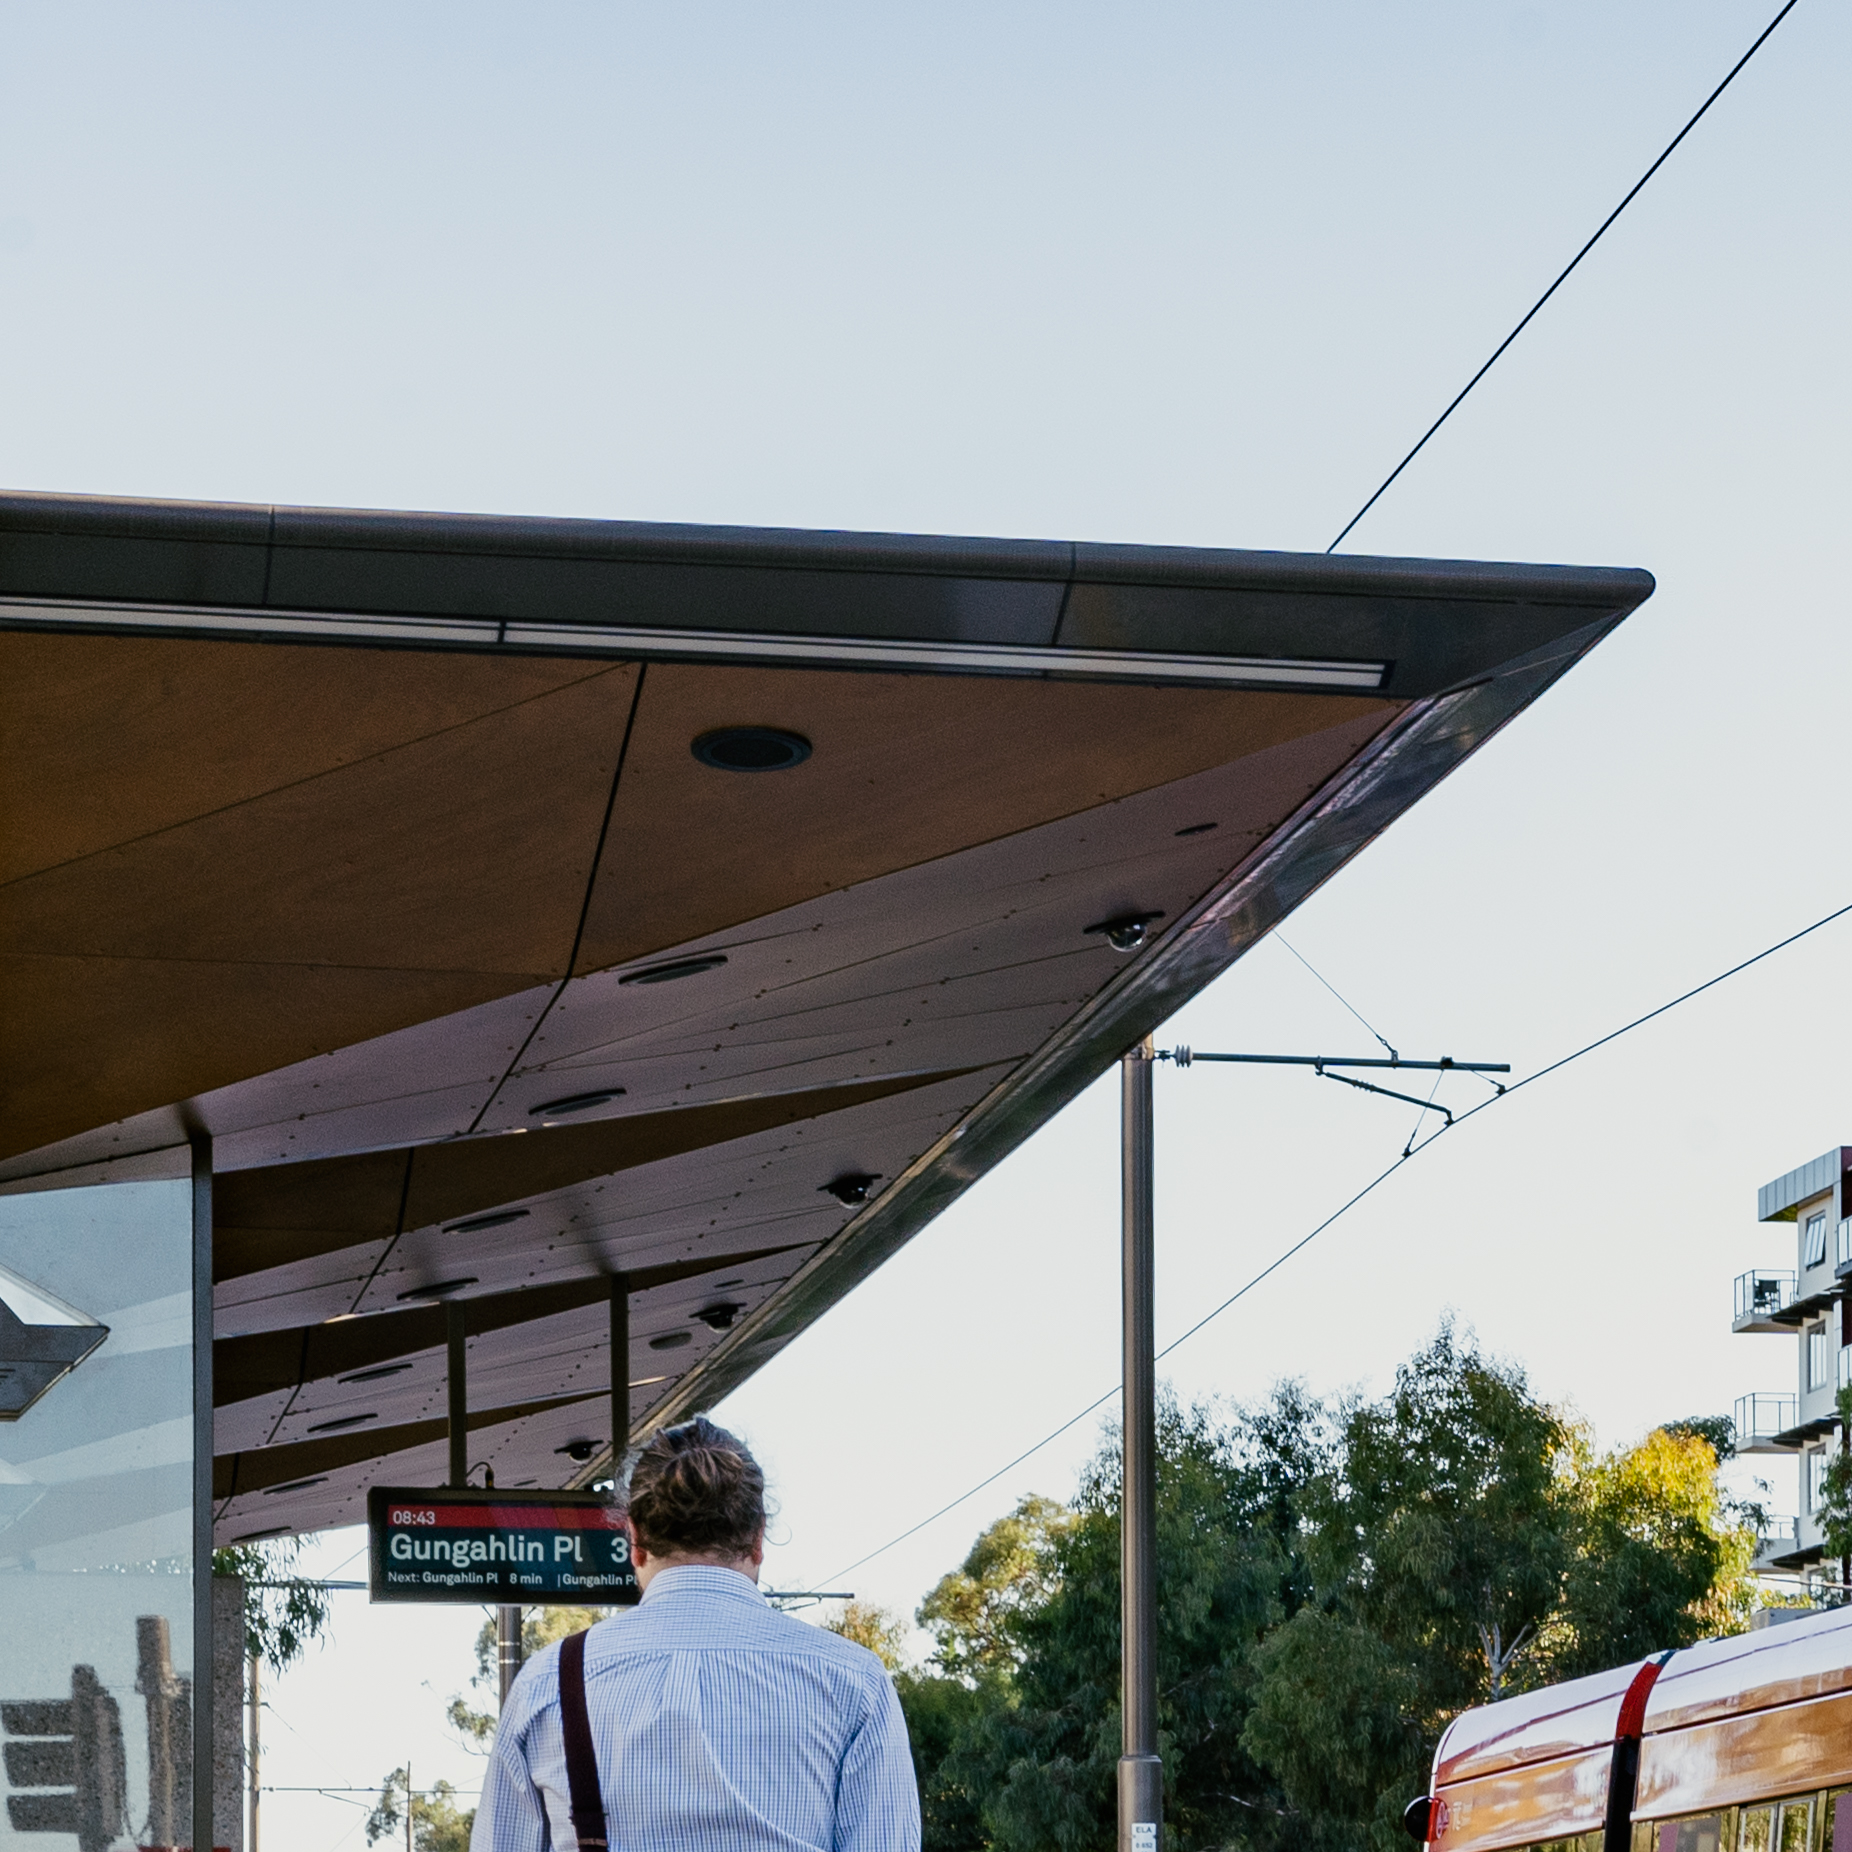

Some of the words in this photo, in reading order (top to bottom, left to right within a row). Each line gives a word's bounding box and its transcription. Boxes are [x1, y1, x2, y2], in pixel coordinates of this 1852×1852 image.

[392, 1510, 436, 1525] 08:43
[390, 1533, 544, 1568] Gungahlin
[554, 1535, 583, 1563] Pl
[388, 1571, 420, 1584] Next:
[422, 1571, 483, 1587] Gungahlin
[486, 1573, 499, 1584] Pl
[509, 1573, 517, 1585] 8
[520, 1572, 543, 1585] min
[1135, 1826, 1152, 1834] ELA
